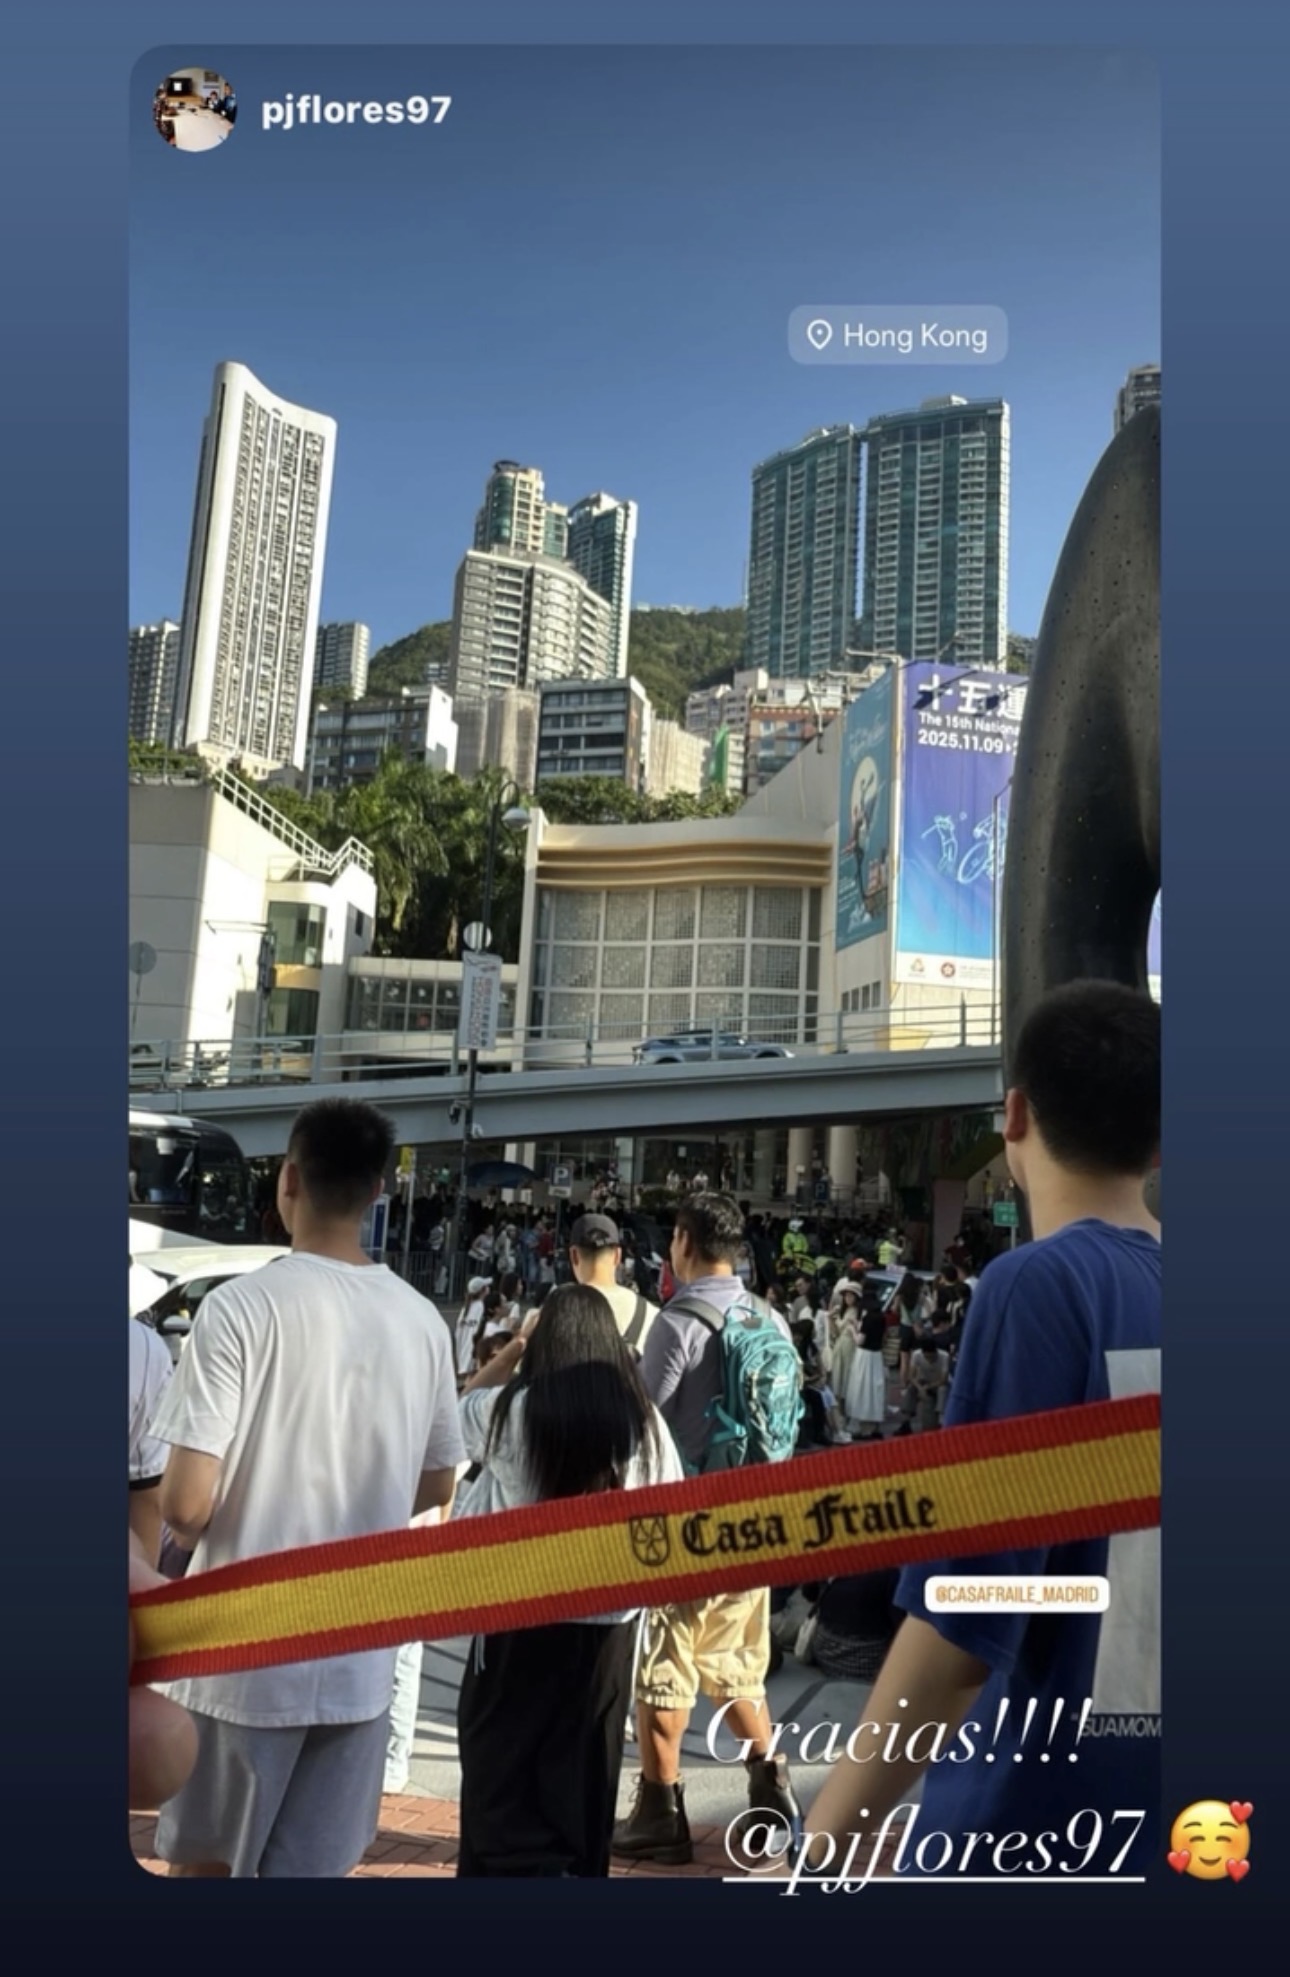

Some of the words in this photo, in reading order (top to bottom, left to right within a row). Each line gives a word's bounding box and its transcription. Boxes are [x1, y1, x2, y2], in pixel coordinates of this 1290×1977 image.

[919, 711, 942, 727] The
[945, 714, 972, 730] 15th
[553, 1167, 568, 1185] P
[681, 1509, 787, 1556] Casa
[803, 1489, 937, 1549] Fraile
